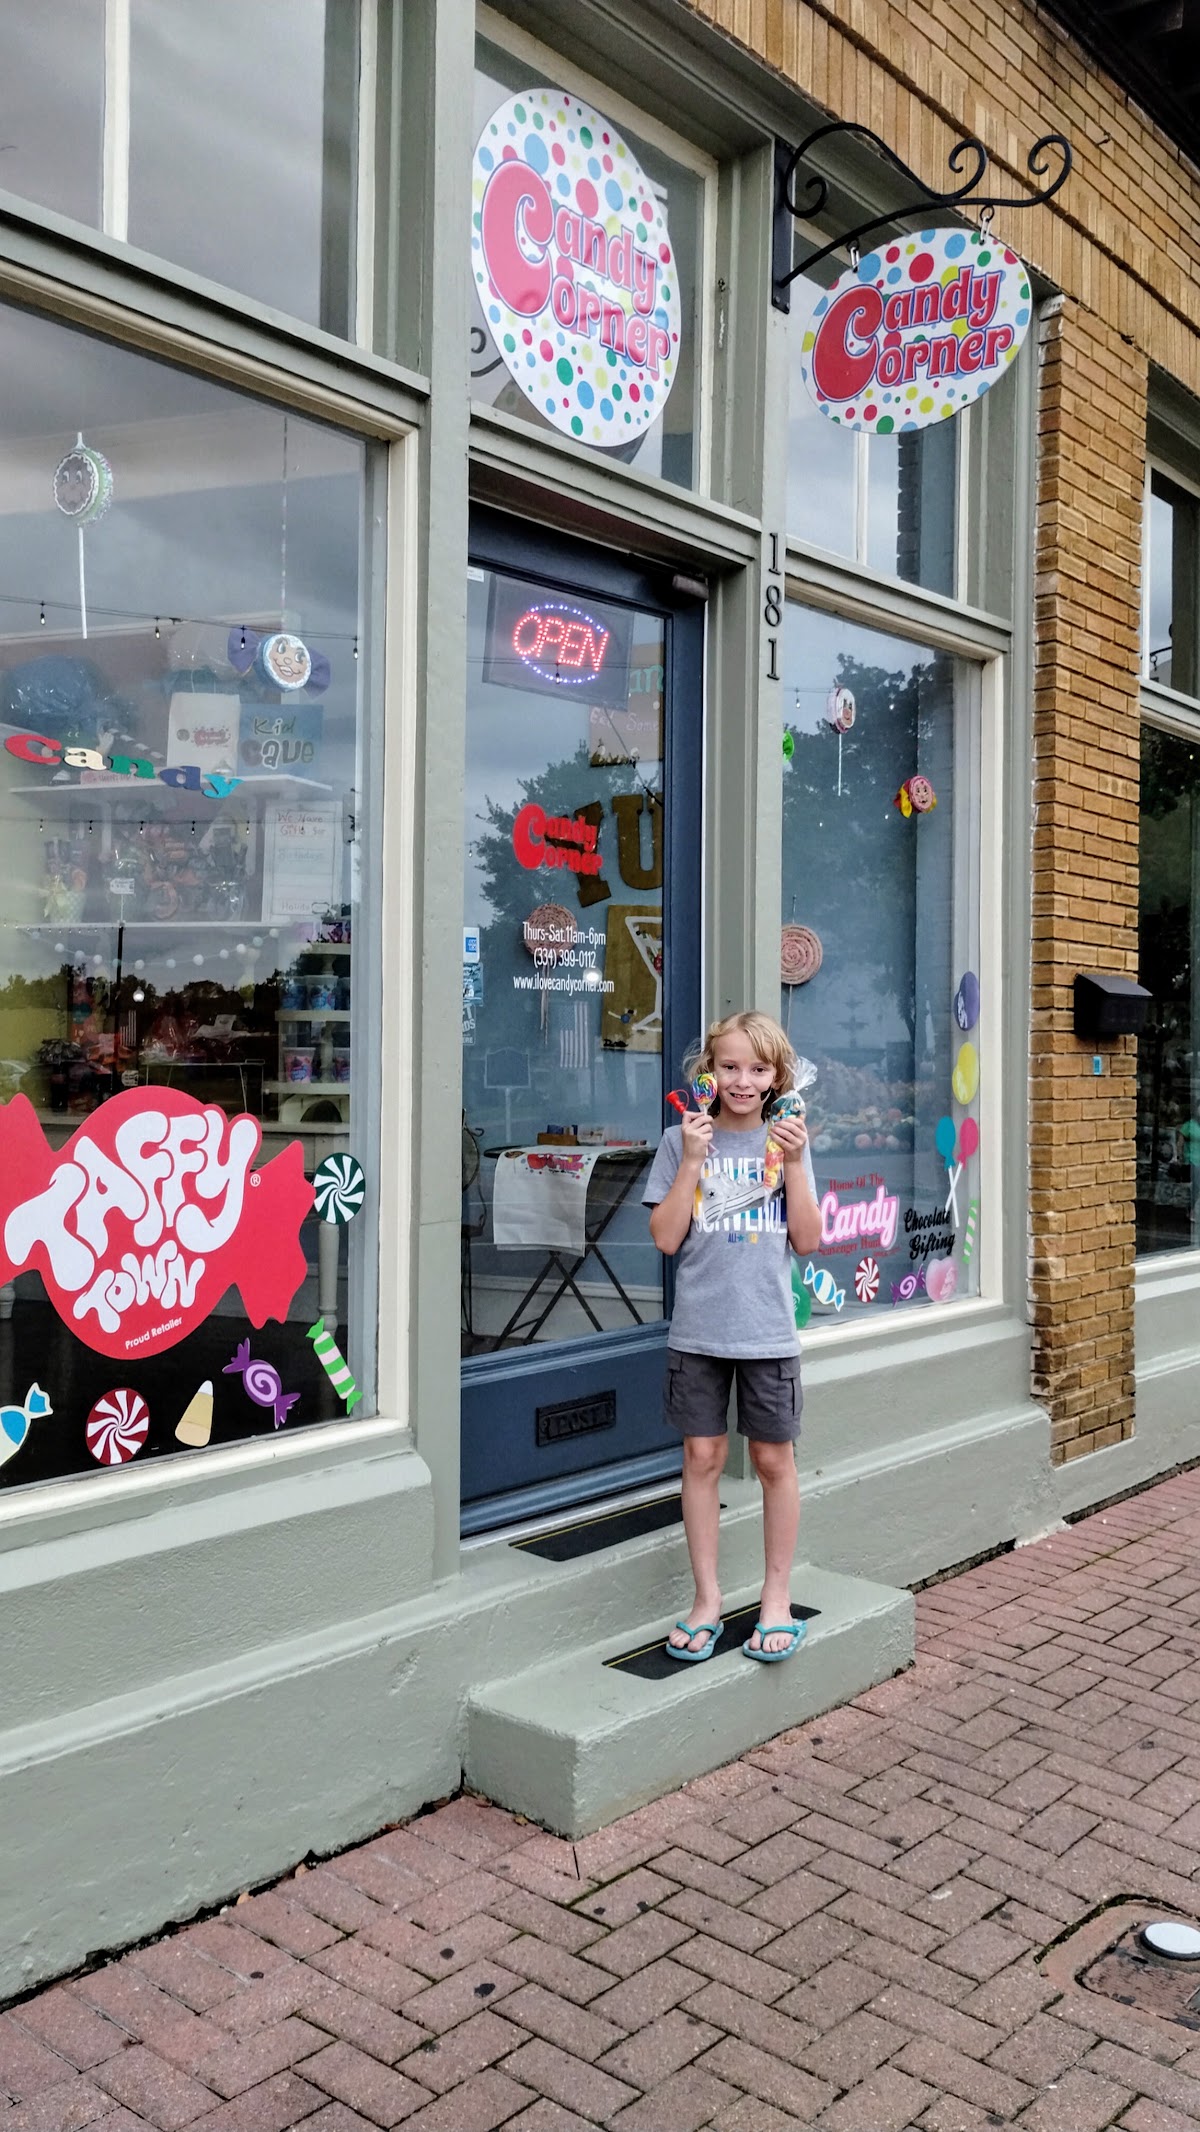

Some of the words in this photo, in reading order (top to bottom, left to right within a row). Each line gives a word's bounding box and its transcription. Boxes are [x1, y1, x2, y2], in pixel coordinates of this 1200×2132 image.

[481, 159, 657, 316] Candy
[812, 265, 1002, 401] Candy
[764, 532, 783, 681] 181
[513, 613, 610, 672] OPEN
[5, 733, 244, 799] Candy
[533, 947, 557, 969] (334)
[558, 949, 597, 969] 399-0112
[4, 1110, 258, 1291] TAFFY
[821, 1185, 898, 1249] Candy
[904, 1206, 951, 1233] Chocolate
[909, 1231, 956, 1261] Gifting
[73, 1240, 206, 1334] TOWN
[125, 1331, 150, 1350] Proud
[151, 1316, 182, 1337] Retailer
